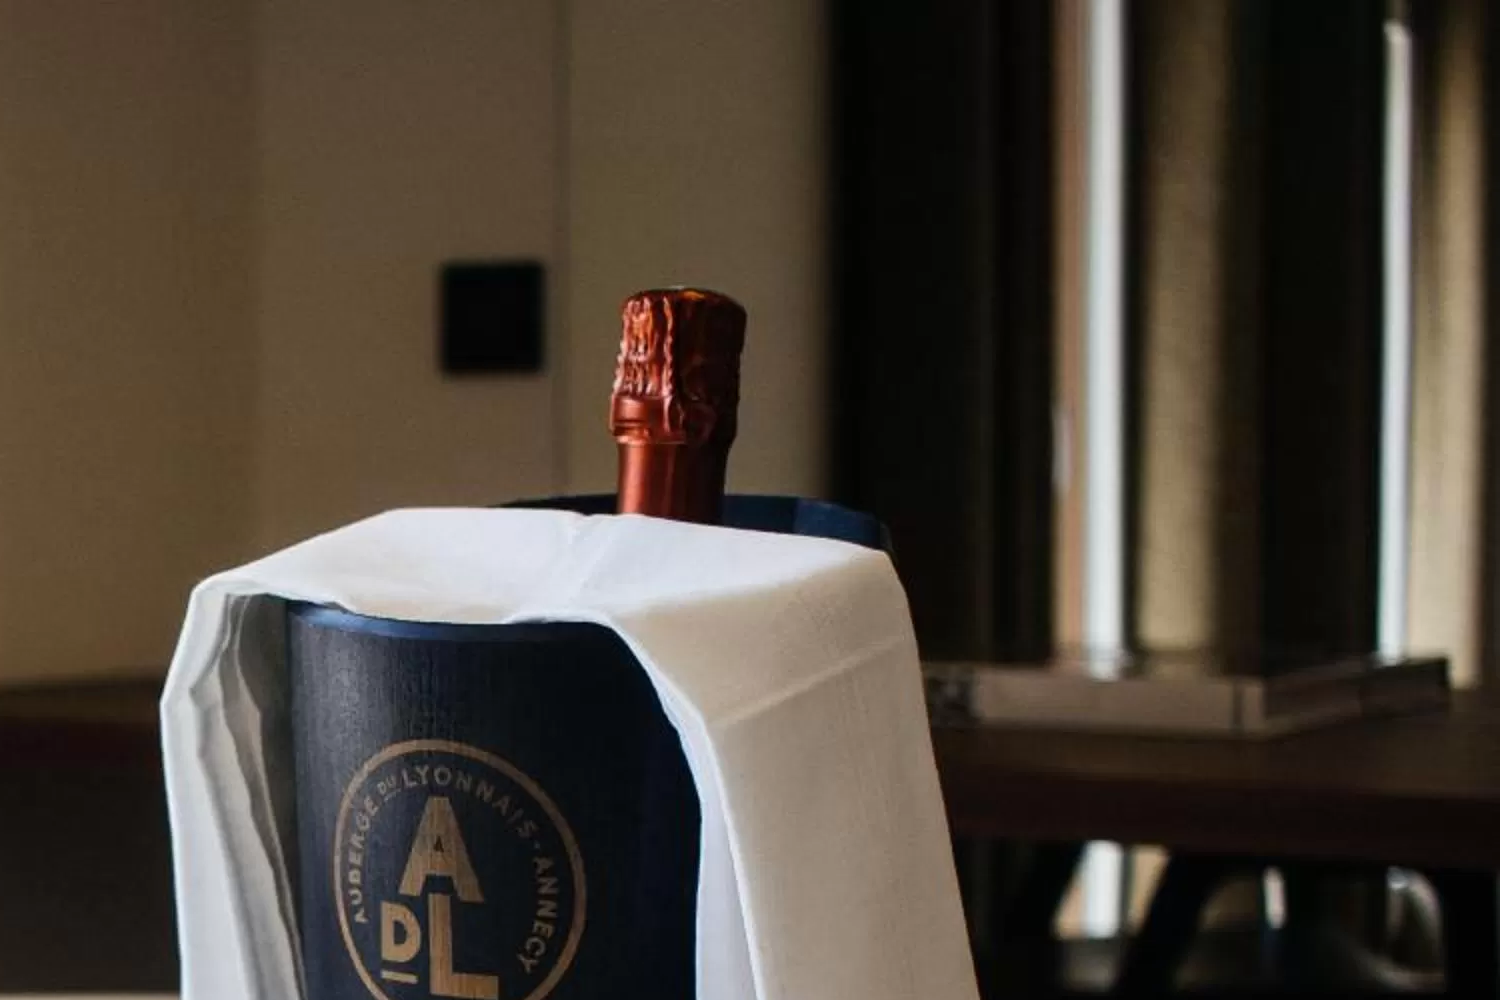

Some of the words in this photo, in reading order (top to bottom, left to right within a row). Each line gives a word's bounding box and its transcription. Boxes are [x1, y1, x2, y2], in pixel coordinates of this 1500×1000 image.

[348, 795, 379, 924] AUBERGE
[377, 773, 399, 796] DU
[401, 764, 538, 839] LYONNAIS
[516, 854, 559, 974] ANNECY
